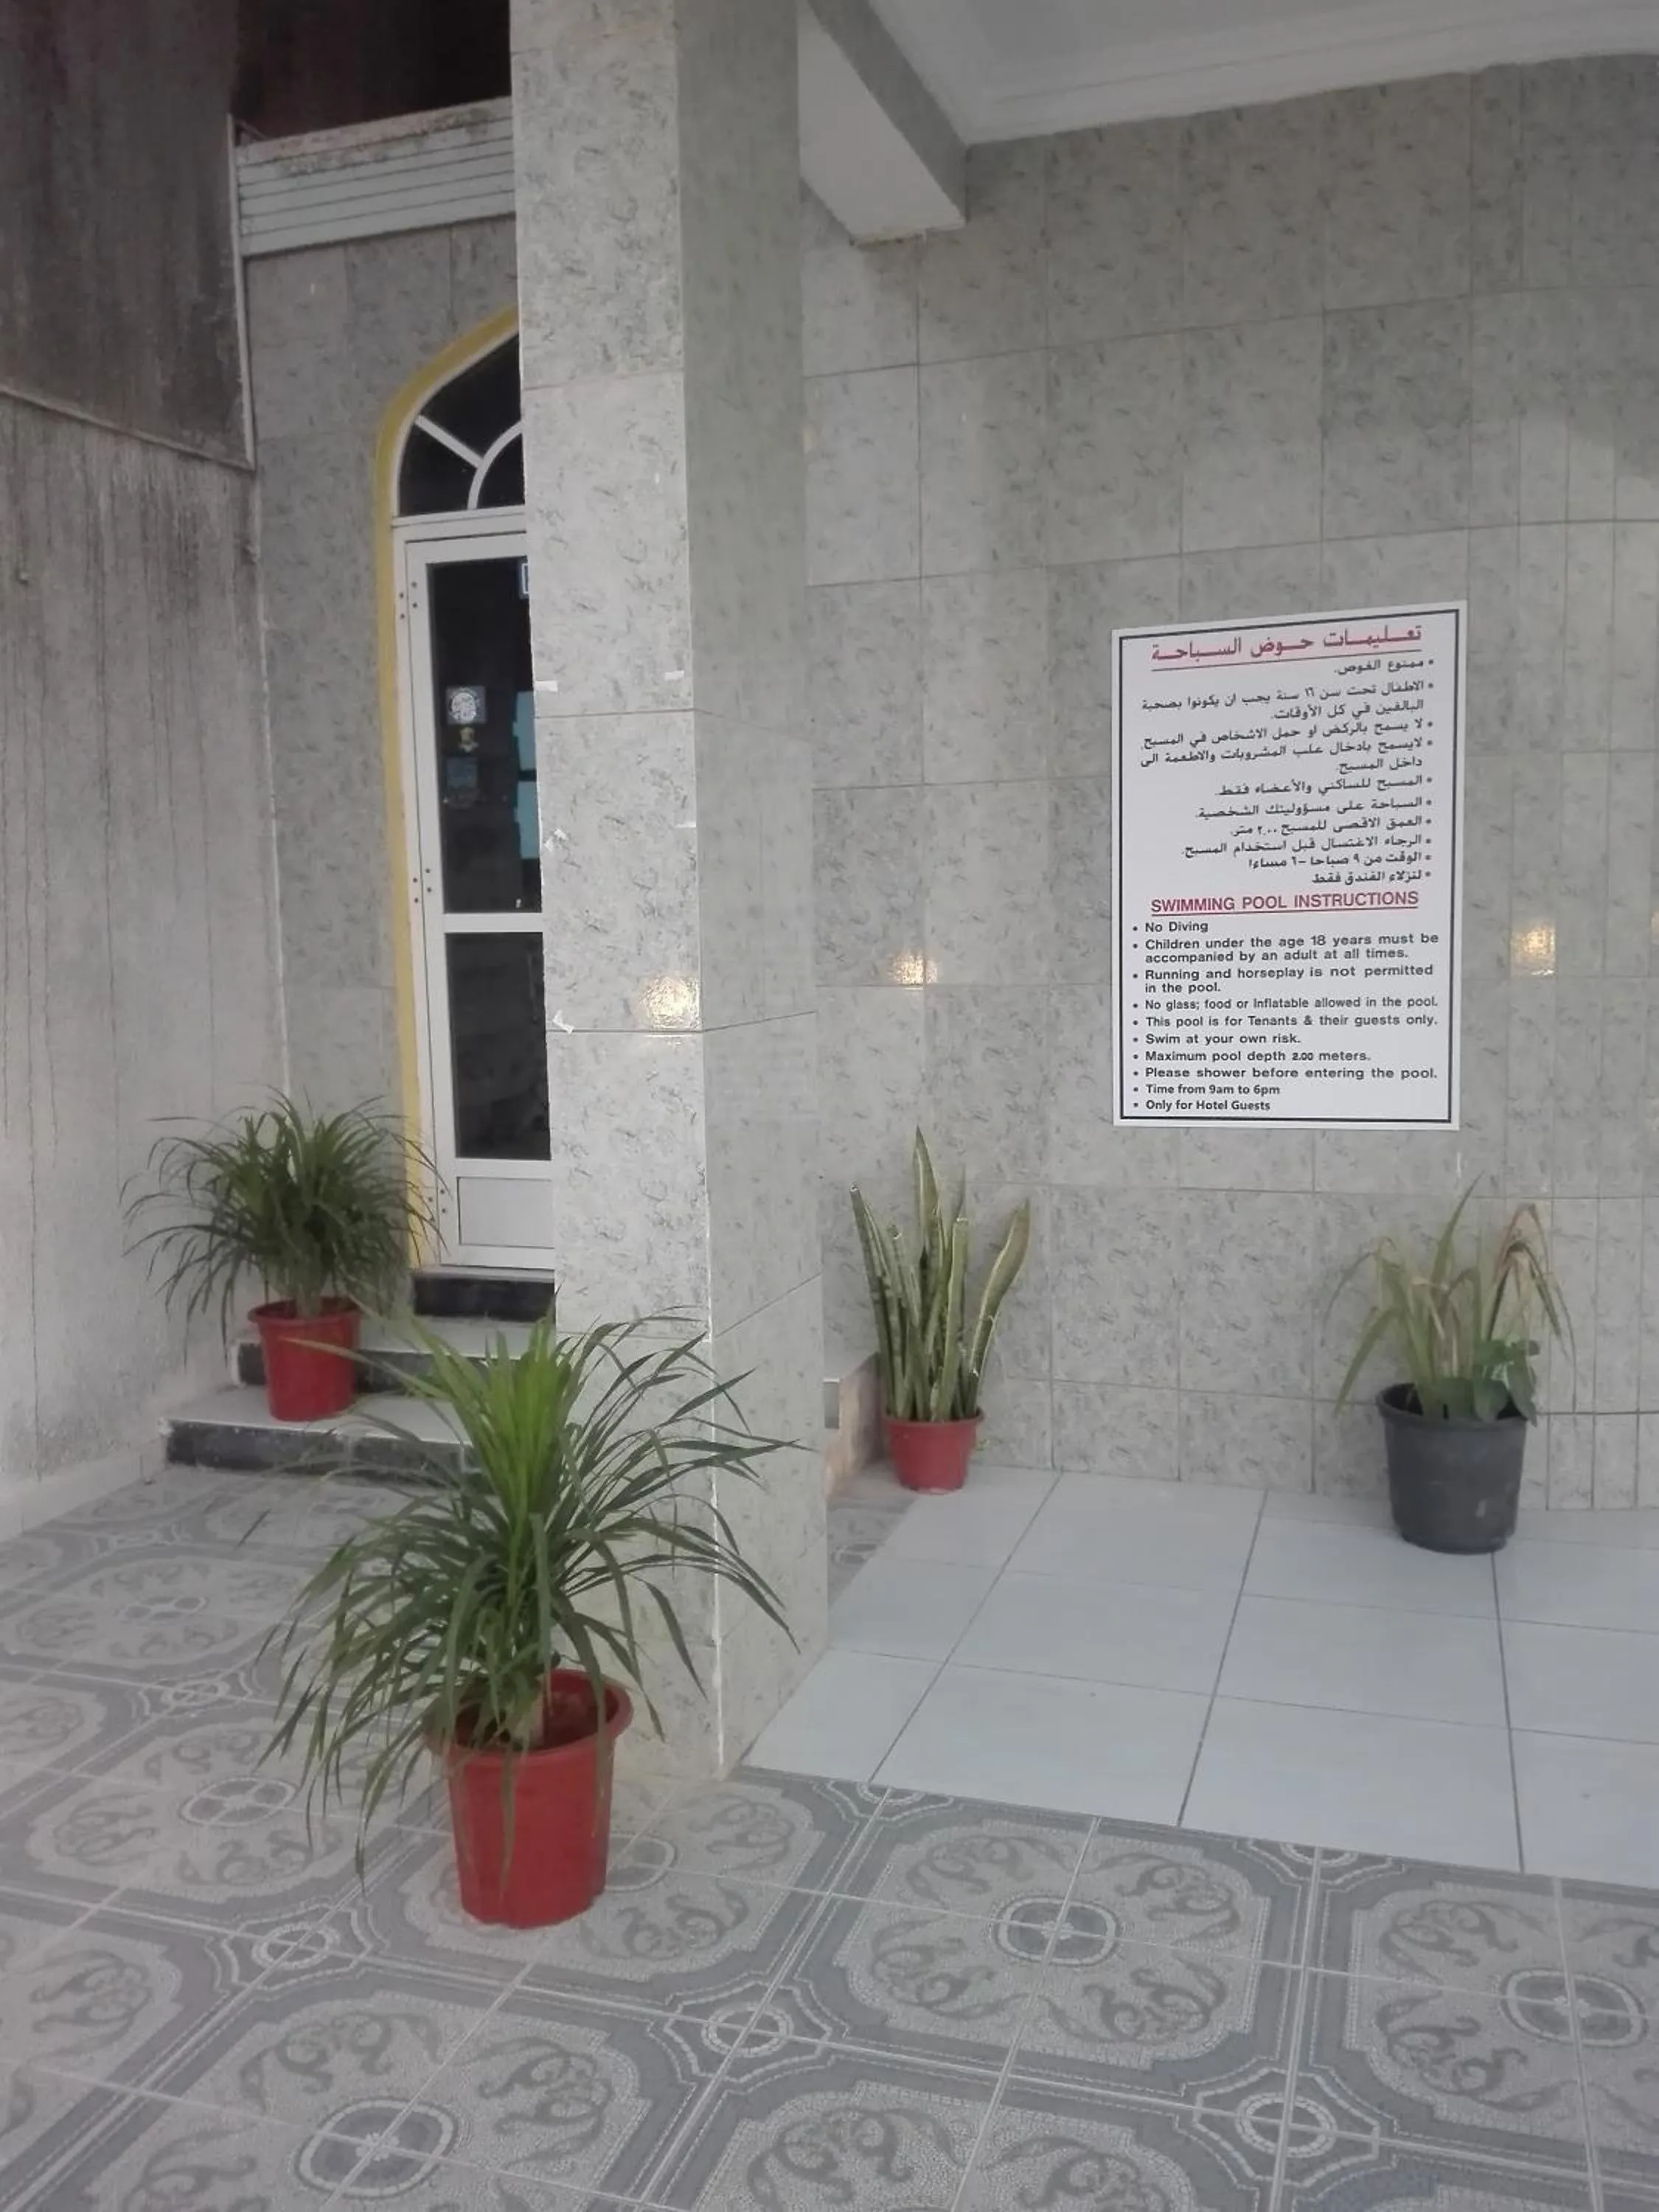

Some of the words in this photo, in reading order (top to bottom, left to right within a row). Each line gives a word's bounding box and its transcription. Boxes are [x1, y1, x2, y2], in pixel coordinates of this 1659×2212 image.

[1323, 625, 1422, 648] تعليمات
[1152, 637, 1241, 661] السباحة
[1251, 637, 1315, 658] حوض
[1388, 660, 1424, 672] ممنوع
[1276, 689, 1299, 700] سنة
[1319, 689, 1341, 700] سن
[1346, 684, 1377, 695] تحت
[1188, 693, 1219, 710] يكونوا
[1241, 695, 1270, 706] يجب
[1327, 703, 1346, 718] كل
[1352, 701, 1371, 719] في
[1374, 723, 1408, 735] يسمح
[1413, 717, 1423, 728] لا
[1189, 731, 1207, 748] في
[1272, 727, 1301, 741] حمل
[1293, 743, 1324, 758] علب
[1389, 757, 1422, 771] داخل
[1377, 775, 1422, 791] المسبح
[1337, 800, 1364, 814] على
[1371, 796, 1422, 810] السباحة
[1281, 819, 1326, 836] للمسبح
[1386, 815, 1422, 830] العمق
[1292, 837, 1315, 852] قبل
[1385, 834, 1422, 846] الرجاء
[1353, 853, 1360, 863] ٩
[1364, 855, 1382, 866] من
[1385, 851, 1422, 864] الوقت
[1312, 872, 1341, 883] فقط
[1345, 872, 1385, 885] الفندق
[1151, 897, 1235, 912] SWIMMING
[1242, 896, 1287, 909] POOL
[1294, 891, 1419, 908] INSTRUCTIONS
[1145, 922, 1163, 933] No
[1169, 921, 1208, 933] Diving
[1145, 939, 1200, 950] Children
[1206, 937, 1244, 949] under
[1251, 936, 1272, 947] the
[1278, 938, 1304, 949] age
[1311, 934, 1326, 946] 18
[1332, 936, 1371, 947] years
[1378, 933, 1414, 945] must
[1420, 932, 1439, 944] be
[1145, 951, 1234, 964] accompanied
[1239, 950, 1255, 963] by
[1262, 951, 1278, 961] an
[1284, 950, 1318, 960] adult
[1324, 950, 1338, 959] at
[1344, 948, 1360, 959] all
[1366, 947, 1409, 959] times.
[1145, 969, 1200, 981] Running
[1206, 967, 1231, 978] and
[1237, 967, 1304, 979] horseplay
[1310, 966, 1323, 977] is
[1329, 966, 1357, 977] not
[1364, 964, 1433, 978] permitted
[1145, 982, 1156, 993] in
[1162, 982, 1183, 992] the
[1188, 981, 1221, 995] pool.
[1145, 1000, 1161, 1010] No
[1166, 999, 1200, 1012] glass;
[1204, 999, 1231, 1009] food
[1237, 999, 1248, 1009] or
[1315, 996, 1361, 1008] allowed
[1366, 997, 1377, 1007] in
[1382, 996, 1402, 1007] the
[1408, 996, 1439, 1009] pool.
[1146, 1017, 1171, 1027] This
[1176, 1016, 1203, 1029] pool
[1208, 1016, 1219, 1026] is
[1225, 1015, 1243, 1026] for
[1248, 1015, 1298, 1026] Tenants
[1304, 1015, 1313, 1026] &
[1319, 1015, 1349, 1026] their
[1354, 1015, 1400, 1027] guests
[1406, 1014, 1439, 1027] only.
[1145, 1033, 1180, 1044] Swim
[1186, 1034, 1199, 1044] at
[1205, 1034, 1234, 1046] your
[1239, 1034, 1267, 1044] own
[1273, 1033, 1301, 1044] risk.
[1145, 1051, 1207, 1062] Maximum
[1212, 1051, 1242, 1062] pool
[1247, 1050, 1287, 1062] depth
[1292, 1052, 1314, 1061] 2.00
[1318, 1051, 1371, 1061] meters.
[1145, 1067, 1190, 1077] Please
[1197, 1067, 1247, 1077] shower
[1252, 1067, 1298, 1077] before
[1305, 1068, 1365, 1080] entering
[1371, 1068, 1395, 1079] the
[1401, 1068, 1438, 1080] pool.
[1146, 1084, 1175, 1094] Time
[1178, 1084, 1206, 1094] from
[1208, 1085, 1234, 1094] 9am
[1238, 1085, 1251, 1094] to
[1253, 1085, 1281, 1097] 6pm
[1146, 1099, 1173, 1112] Only
[1176, 1099, 1193, 1110] for
[1196, 1099, 1228, 1110] Hotel
[1231, 1100, 1271, 1110] Guests
